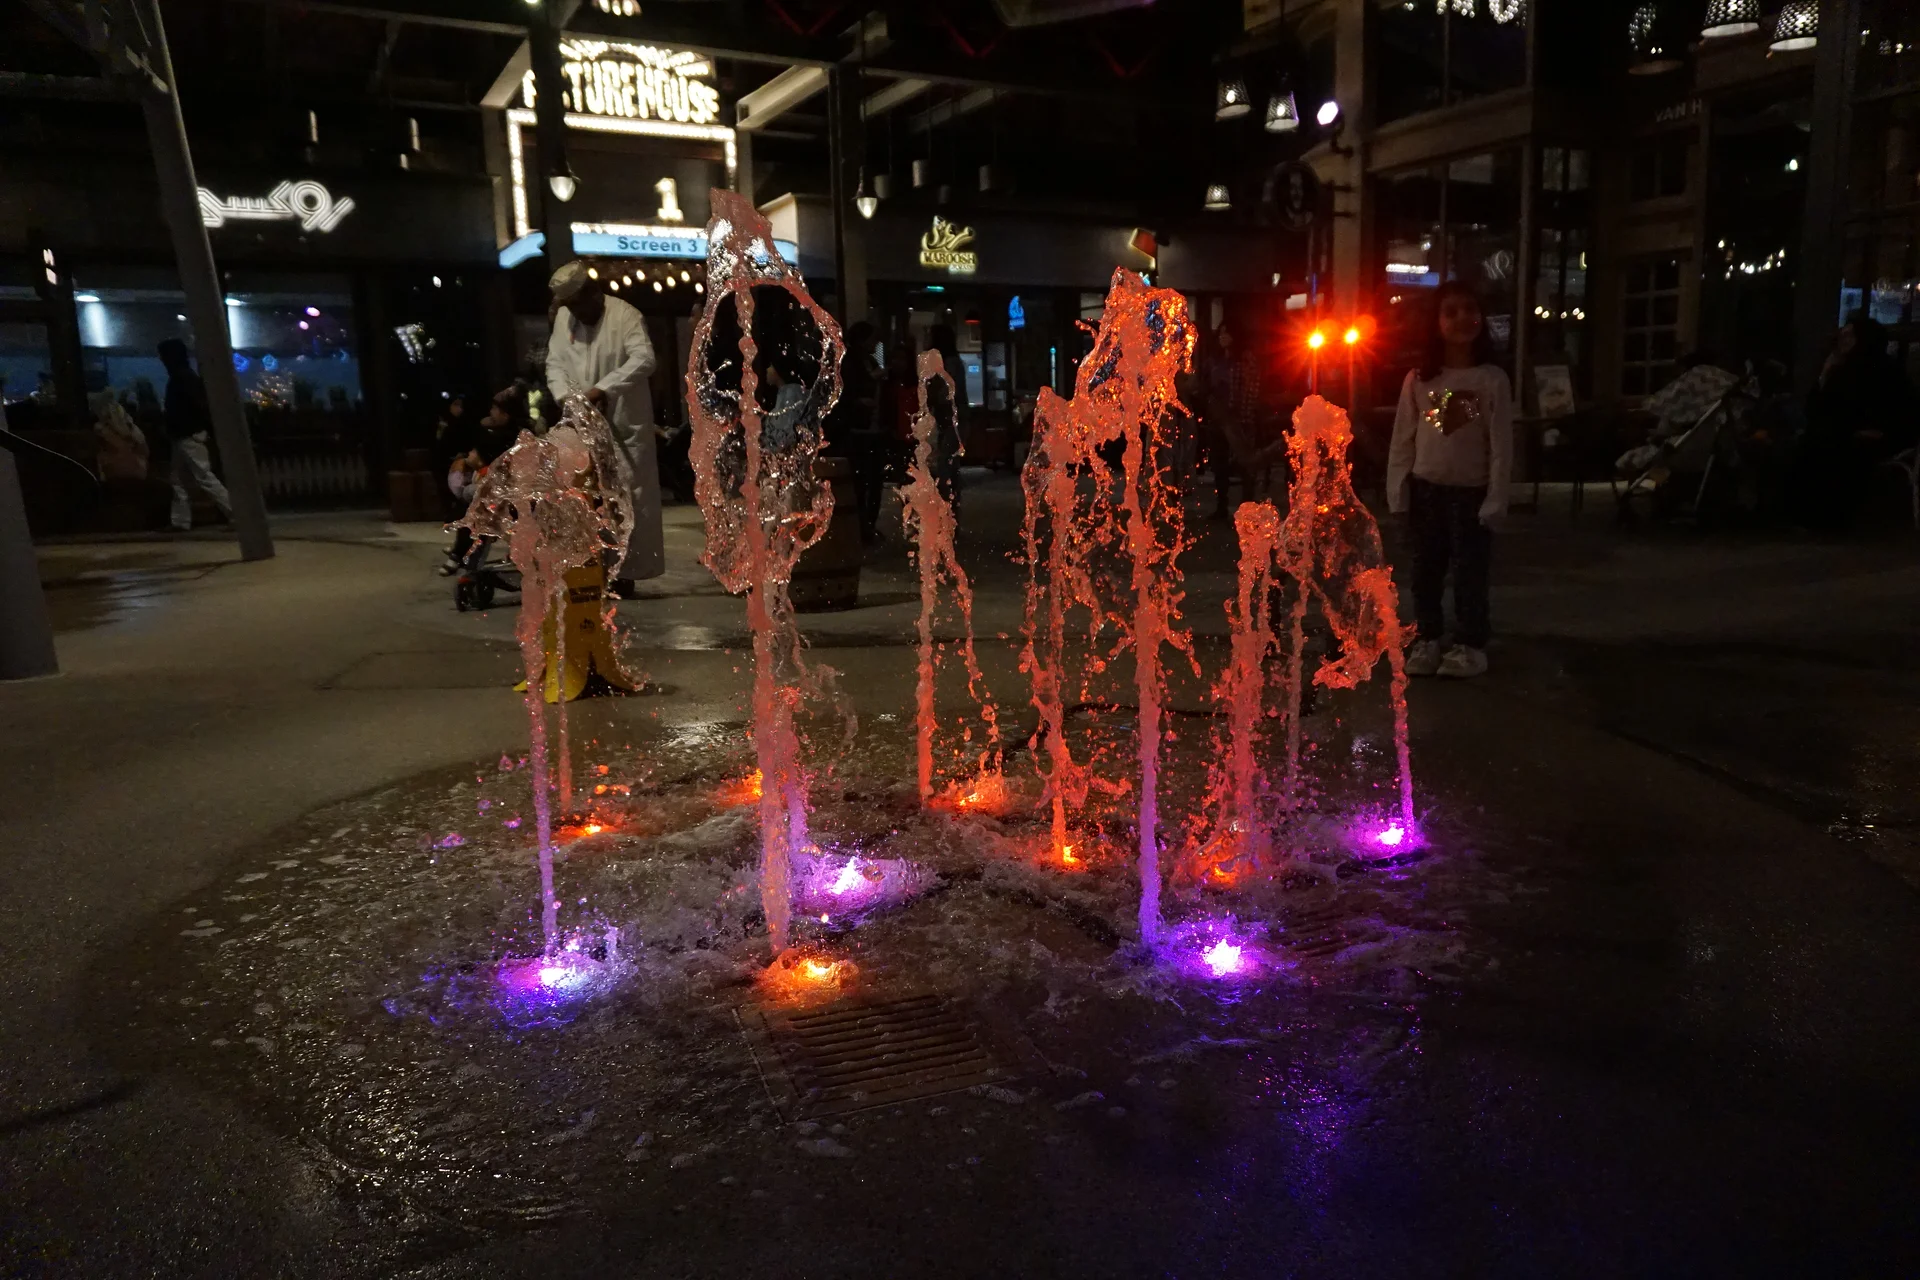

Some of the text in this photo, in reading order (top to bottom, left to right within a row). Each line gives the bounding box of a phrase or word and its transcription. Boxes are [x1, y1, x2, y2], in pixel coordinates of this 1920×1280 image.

[655, 177, 683, 221] 1
[617, 236, 698, 252] Screen 3
